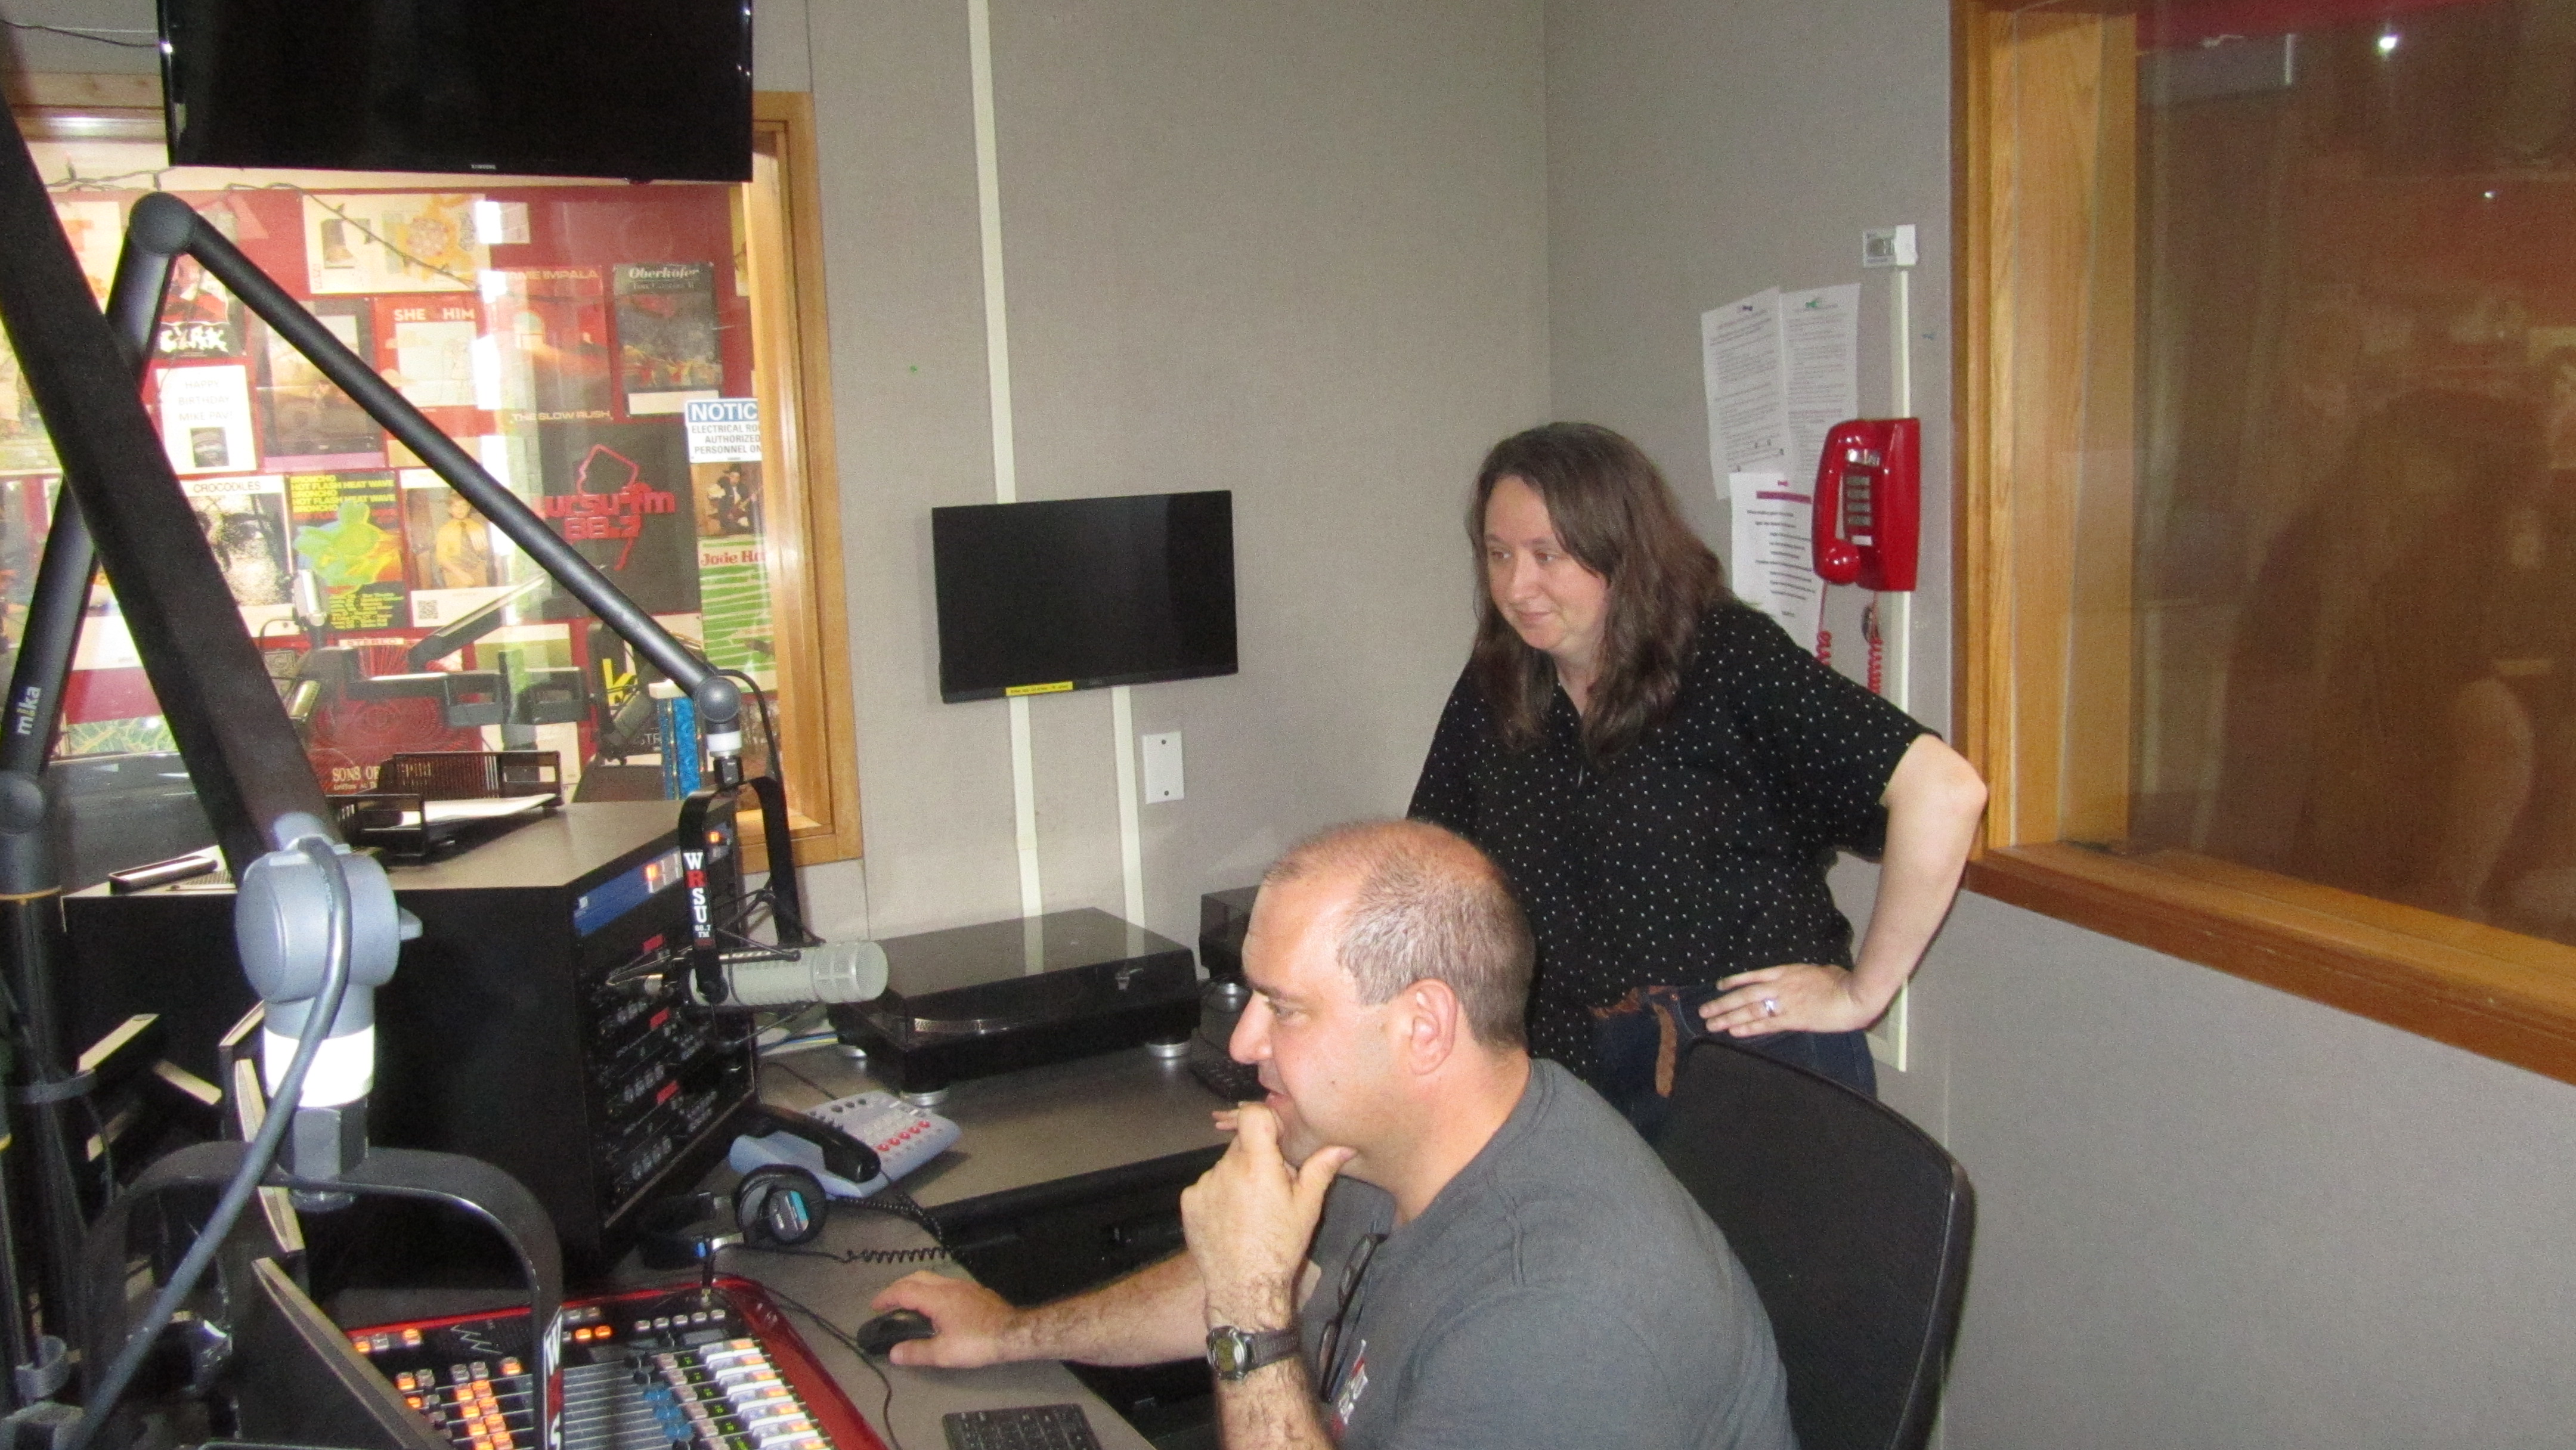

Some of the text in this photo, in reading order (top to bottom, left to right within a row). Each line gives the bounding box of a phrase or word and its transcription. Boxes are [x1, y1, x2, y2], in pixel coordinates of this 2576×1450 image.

[543, 270, 598, 280] IMPALA
[394, 307, 475, 321] SHE HIM
[185, 380, 219, 389] HAPPY
[179, 395, 230, 405] BIRTHDAY
[179, 411, 206, 422] MIKE
[575, 410, 611, 419] RUSH
[692, 402, 758, 421] NOTIC
[692, 424, 744, 434] ELECTRICAL
[704, 434, 761, 444] AUTHORIZED
[695, 445, 747, 454] PERSONNEL
[193, 481, 262, 493] CROCODILES
[369, 479, 395, 488] WAVE
[16, 686, 42, 735] mika
[332, 766, 380, 782] SONS OF
[683, 851, 708, 923] WRSU
